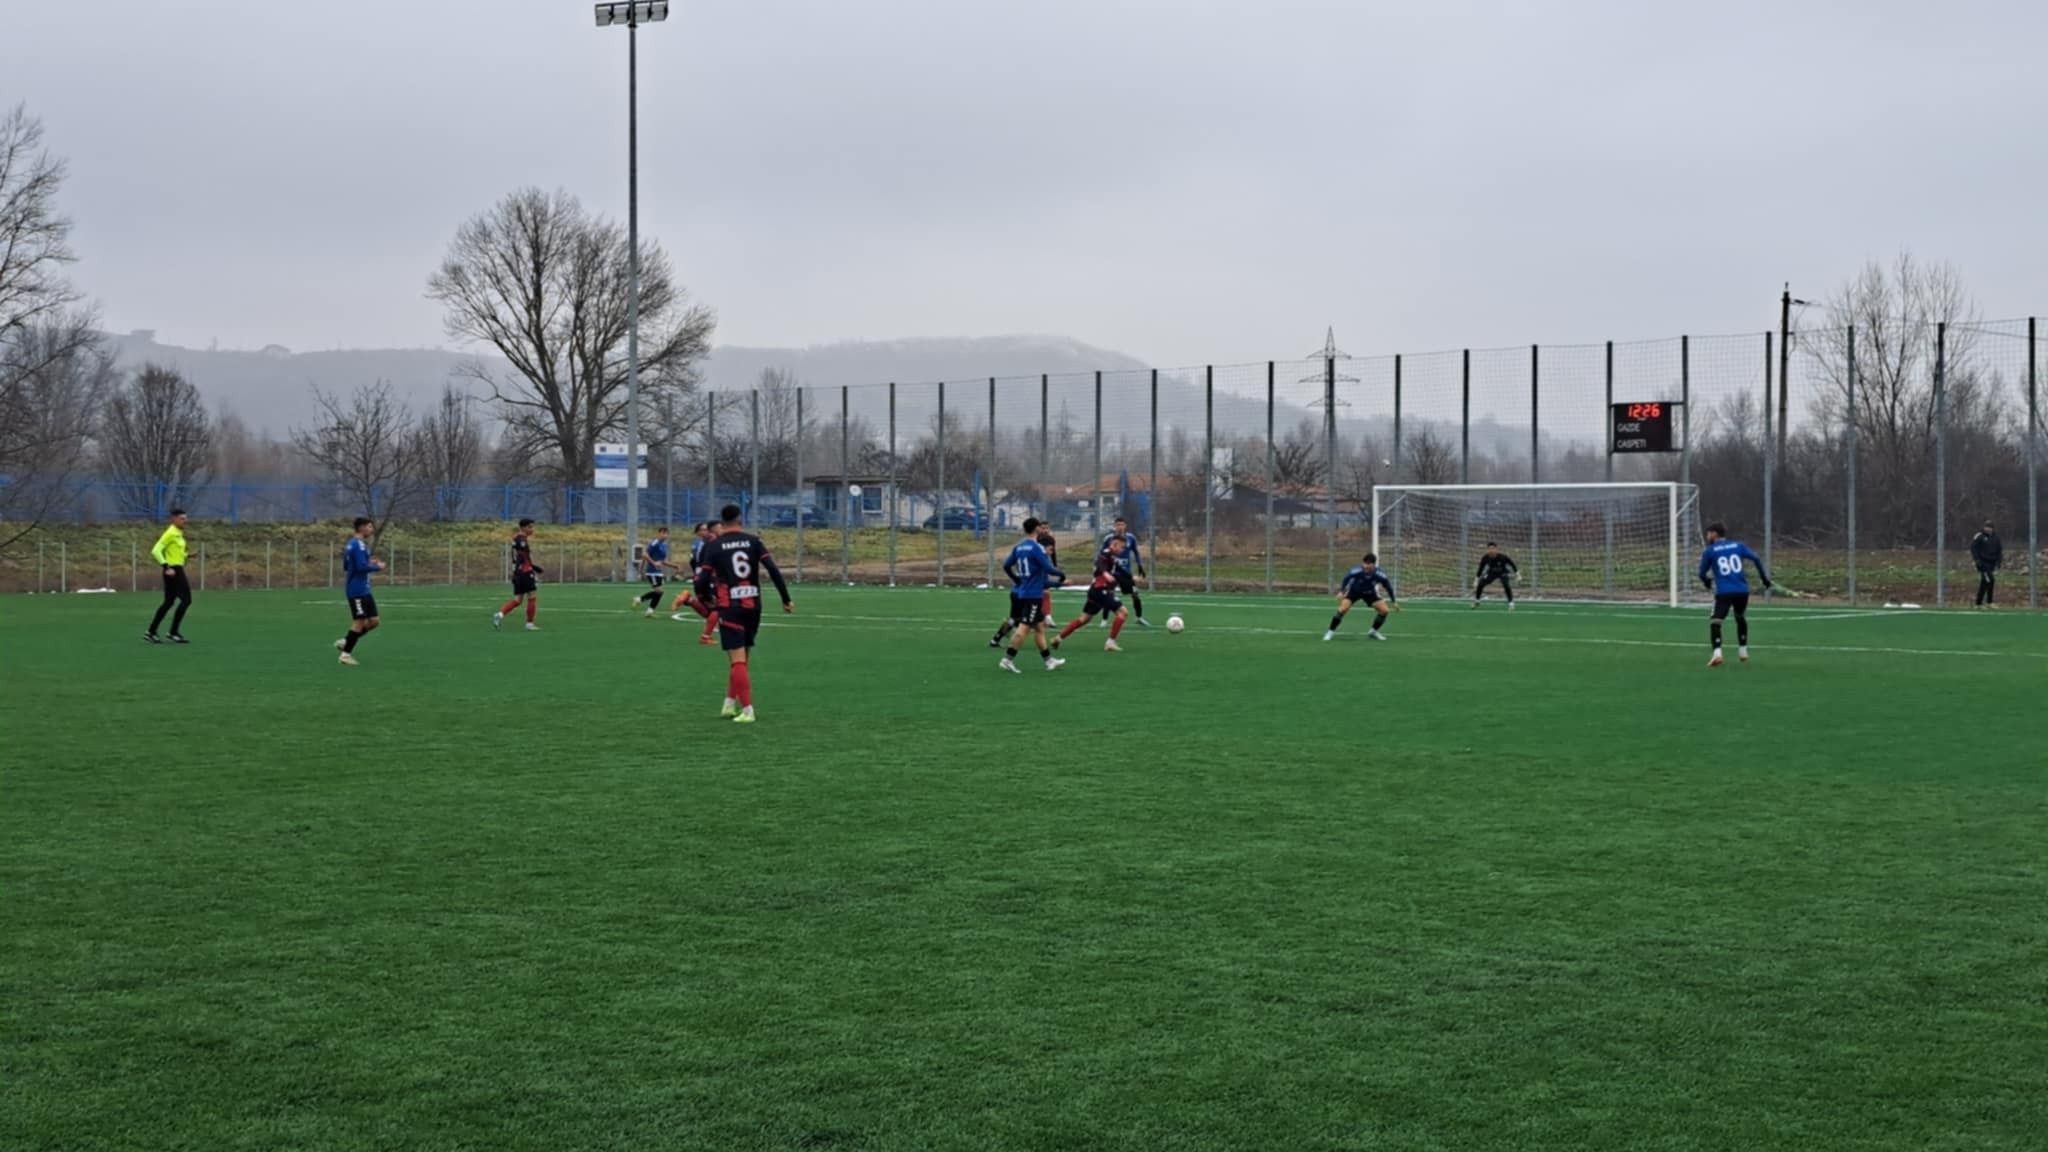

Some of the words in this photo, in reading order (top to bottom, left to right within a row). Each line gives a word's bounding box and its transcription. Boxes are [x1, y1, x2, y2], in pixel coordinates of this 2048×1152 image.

[731, 550, 751, 579] 6
[1015, 557, 1031, 577] 11
[1717, 553, 1742, 576] 80
